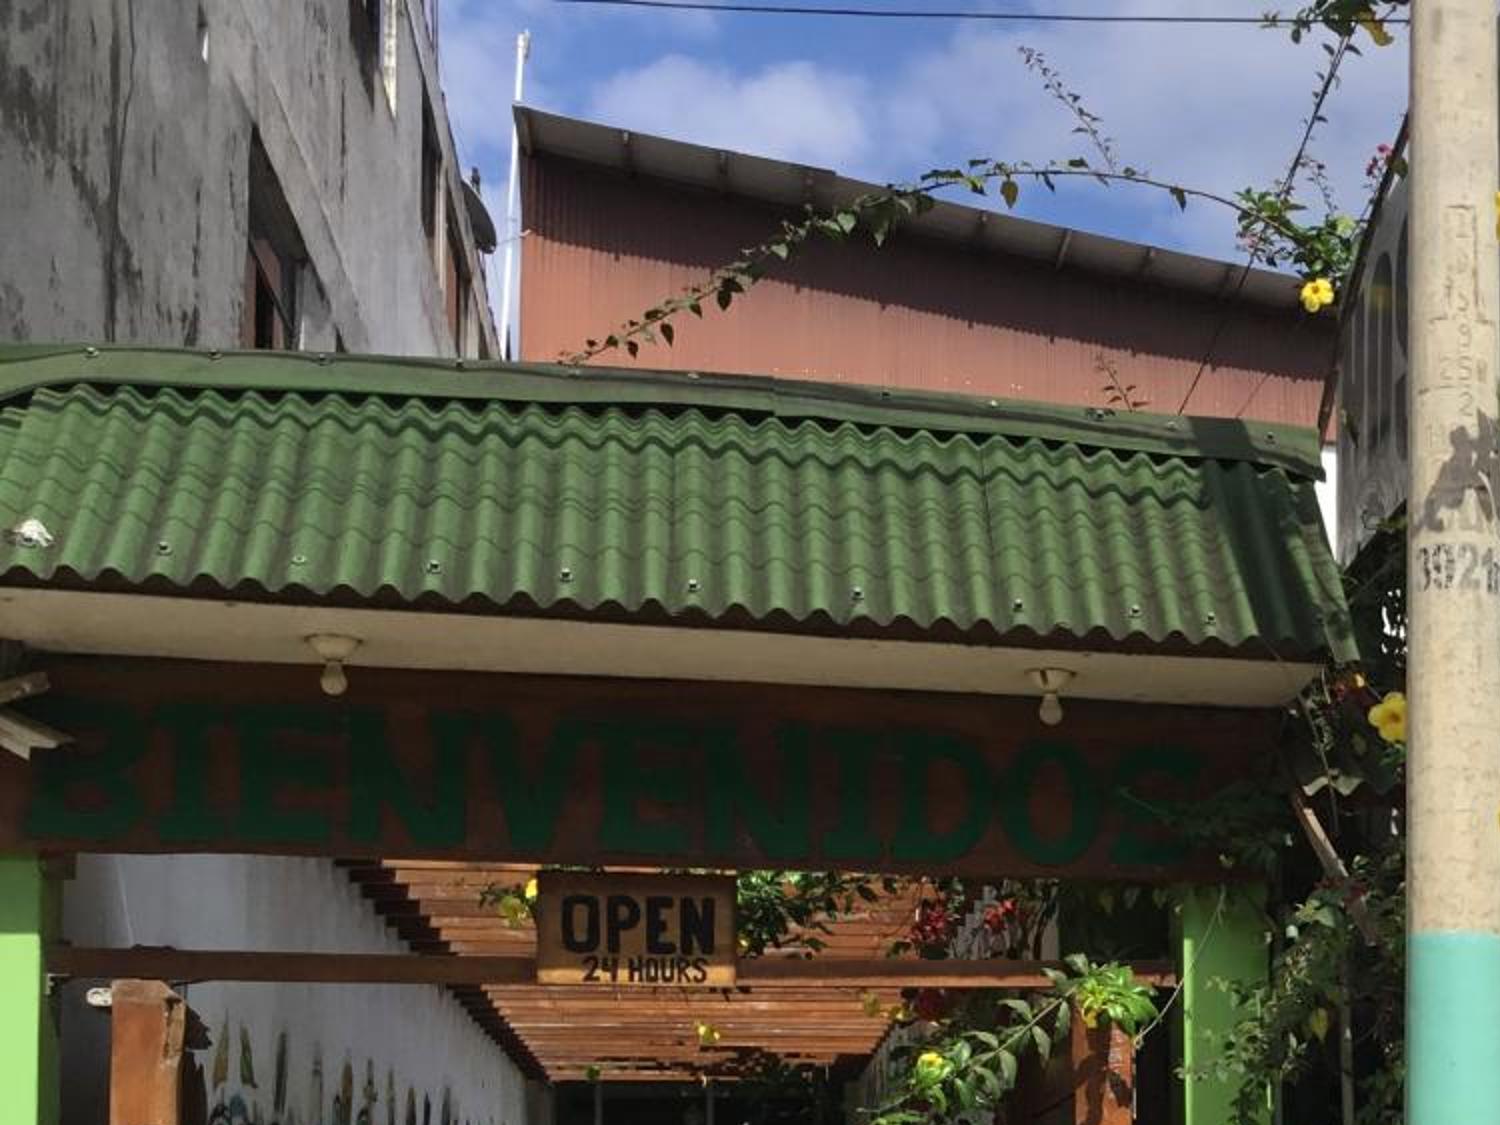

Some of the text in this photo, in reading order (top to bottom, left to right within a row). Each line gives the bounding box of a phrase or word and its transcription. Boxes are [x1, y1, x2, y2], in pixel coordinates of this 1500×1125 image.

[24, 700, 1208, 865] BIENVENIDOS
[561, 894, 715, 955] OPEN
[583, 955, 708, 984] 24 HOURS
